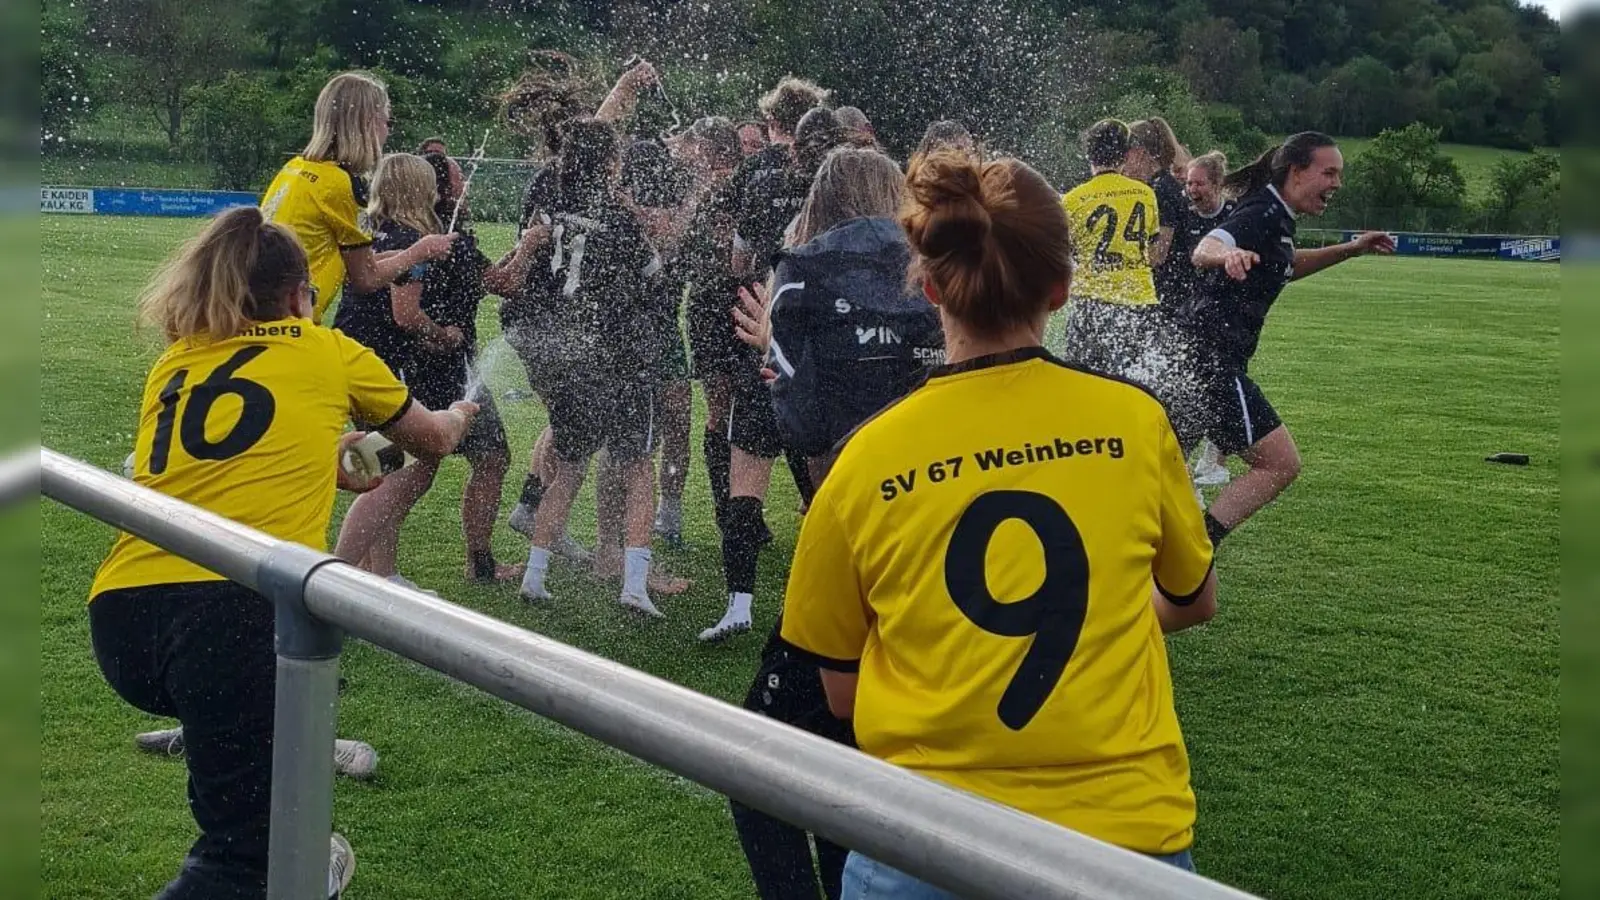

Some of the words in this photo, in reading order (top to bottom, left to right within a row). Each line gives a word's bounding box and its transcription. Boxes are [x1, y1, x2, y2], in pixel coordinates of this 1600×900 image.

[40, 199, 67, 209] KALK
[69, 200, 84, 210] KG
[50, 188, 89, 199] KAIDER
[1086, 201, 1148, 272] 24
[148, 344, 276, 475] 16
[880, 469, 917, 502] SV
[927, 456, 963, 483] 67
[974, 436, 1124, 471] Weinberg
[945, 489, 1090, 732] 9
